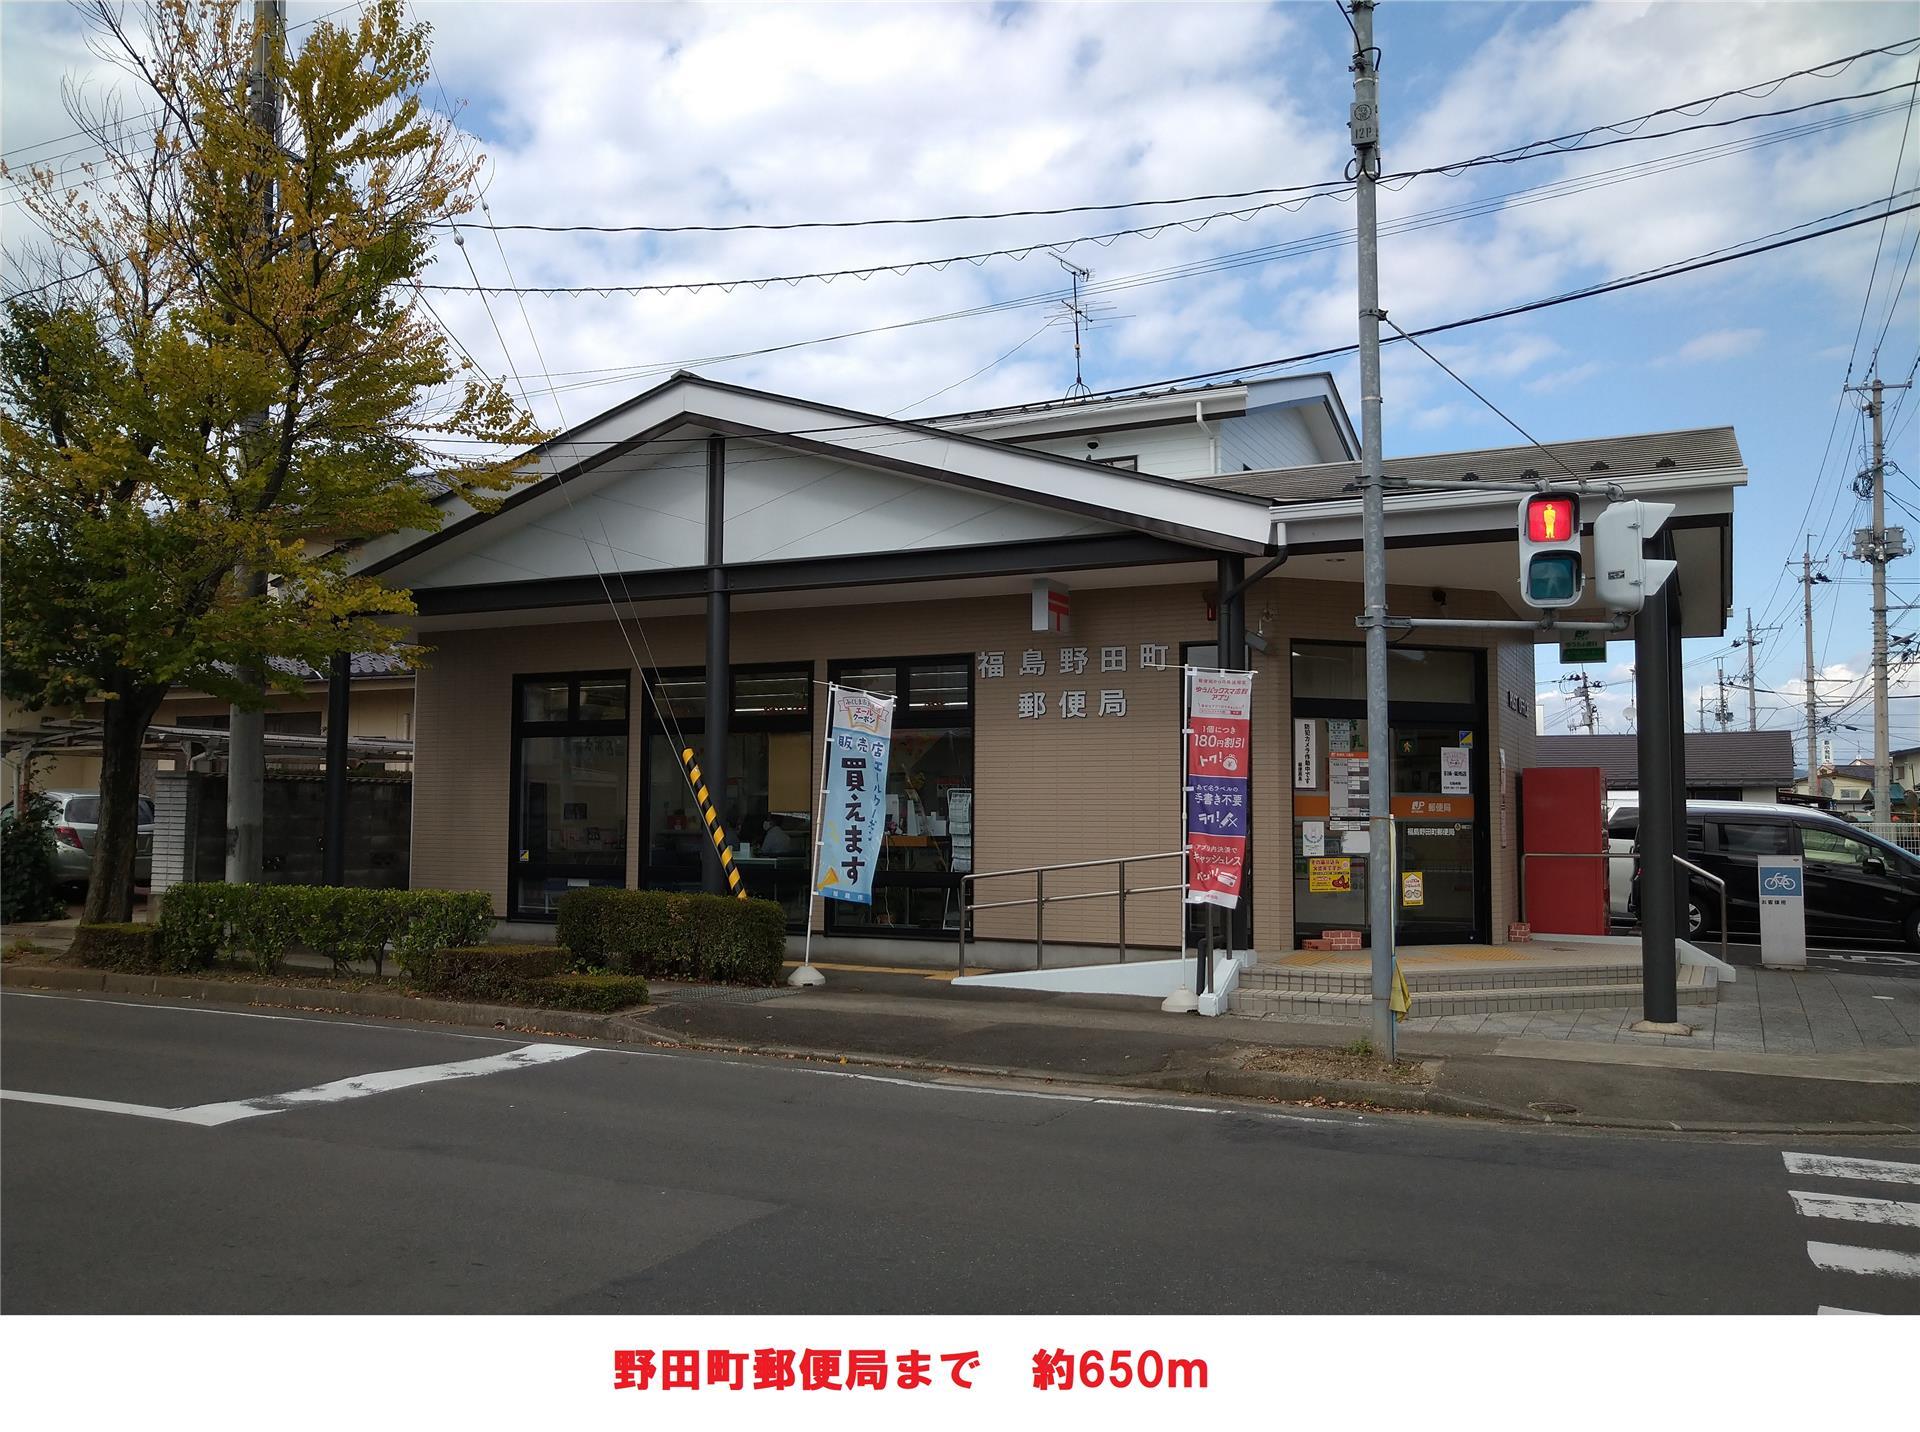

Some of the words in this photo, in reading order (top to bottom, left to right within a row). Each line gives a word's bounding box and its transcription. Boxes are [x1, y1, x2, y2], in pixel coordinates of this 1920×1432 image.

[978, 643, 1169, 678] 福島野田町
[1018, 689, 1127, 719] 郵便局
[856, 707, 873, 716] エール
[853, 713, 876, 724] クーポン
[1202, 725, 1236, 734] 1個につき
[838, 735, 884, 758] 販売店
[1194, 734, 1245, 748] 180円割引
[1196, 784, 1239, 792] あて名ラベルの
[1194, 793, 1243, 806] 手書き不要
[1428, 802, 1452, 812] 郵便局
[841, 757, 866, 885] 買えます
[1193, 852, 1241, 866] キャッシュレス
